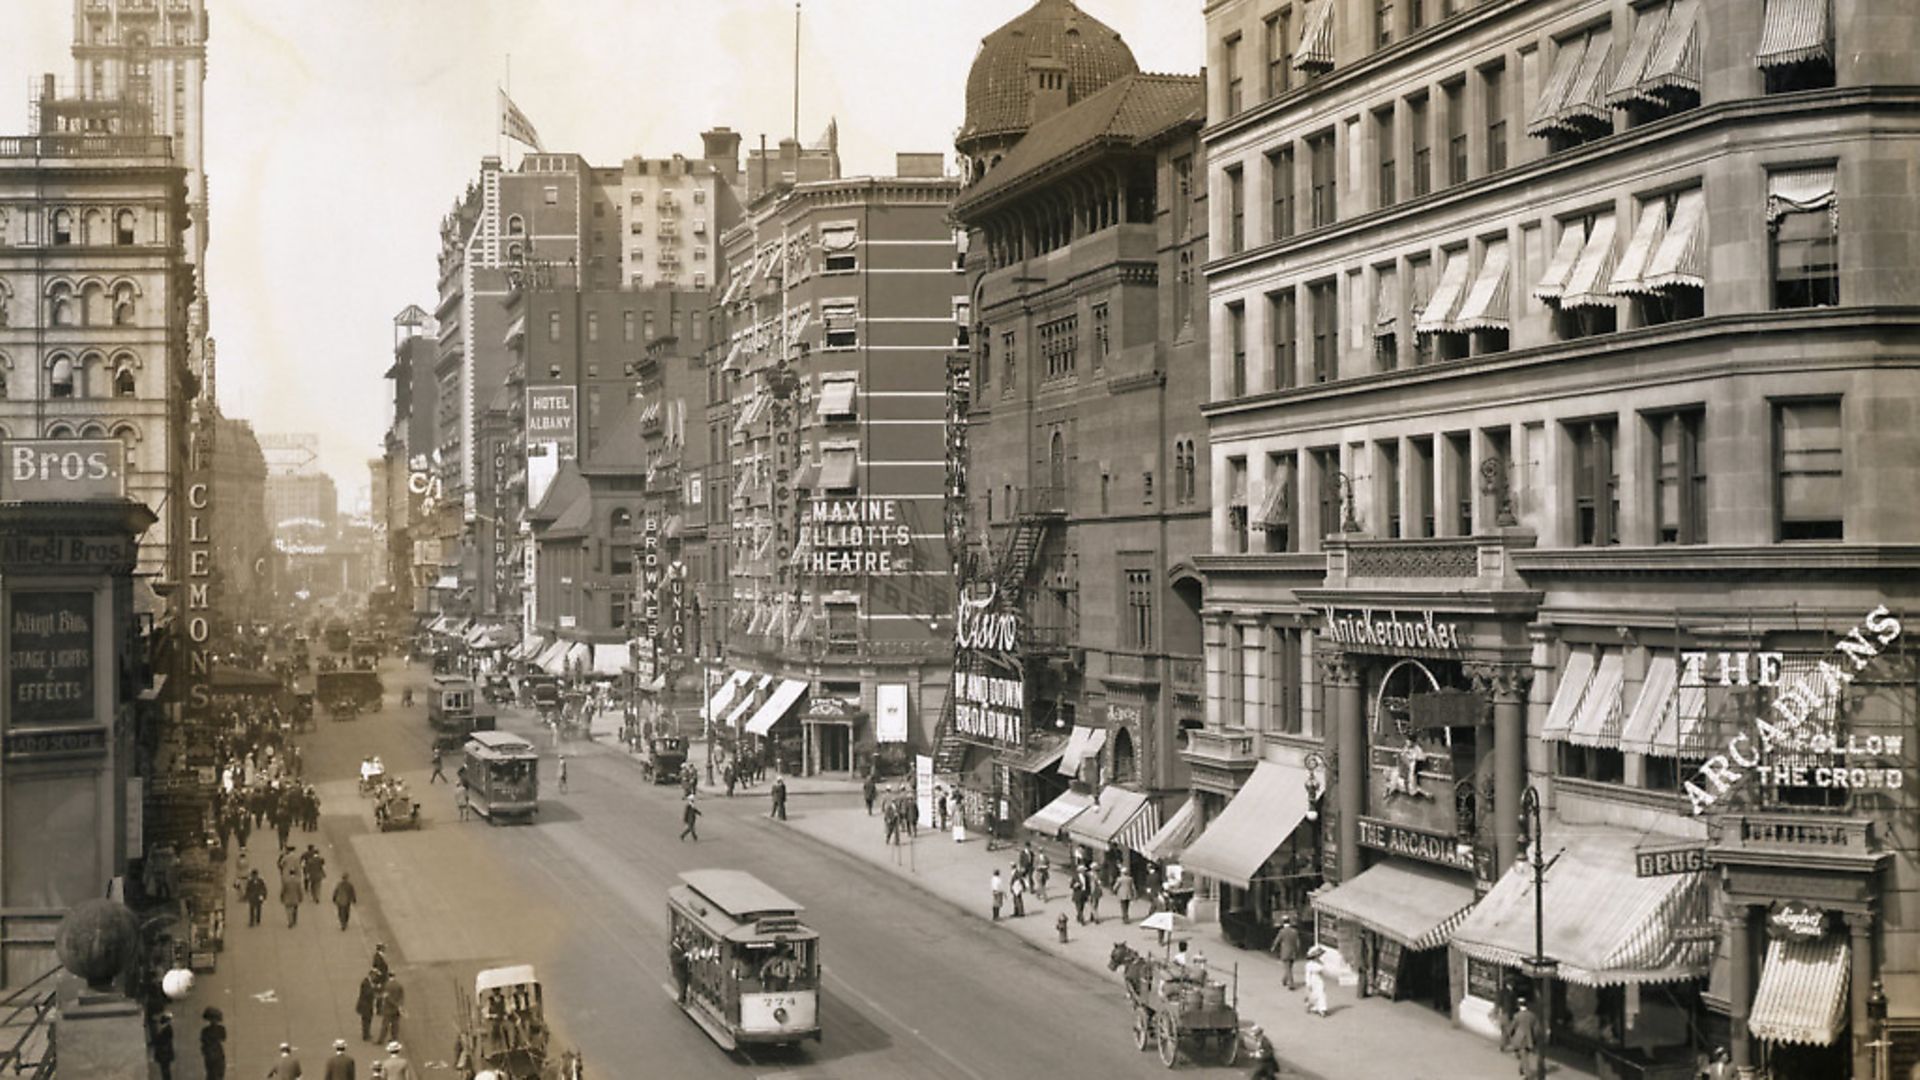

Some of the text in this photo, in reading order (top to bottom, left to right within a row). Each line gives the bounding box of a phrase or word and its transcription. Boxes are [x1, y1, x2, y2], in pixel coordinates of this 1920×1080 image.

[533, 396, 570, 409] HOTEL
[530, 417, 570, 430] ALBANY
[12, 446, 118, 481] Bros.
[812, 501, 896, 521] MAXINE
[801, 526, 910, 546] ELLIOTT'S
[802, 551, 892, 572] THEATRE
[189, 484, 209, 709] CLEMONS
[1325, 605, 1459, 649] Knickerbocker
[1681, 652, 1784, 687] THE
[18, 682, 82, 701] EFFECTS
[1684, 604, 1902, 815] ARCADIANS
[1796, 733, 1903, 755] FOLLOW
[1757, 766, 1903, 789] THE CROWD
[1358, 821, 1386, 847] THE
